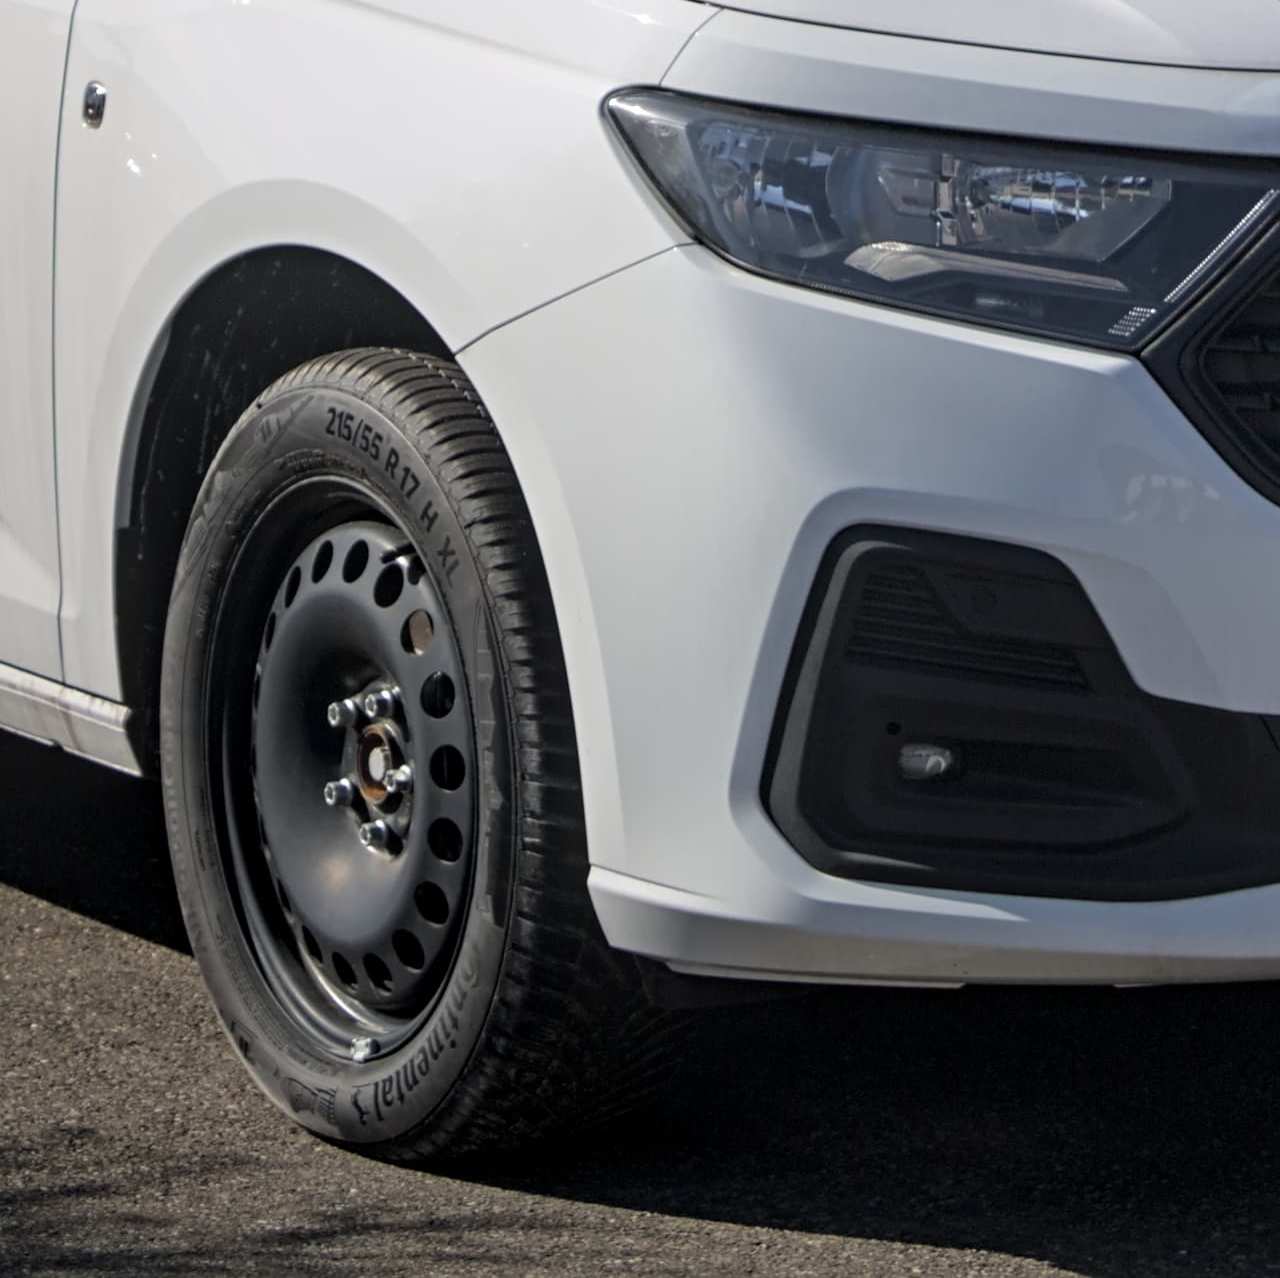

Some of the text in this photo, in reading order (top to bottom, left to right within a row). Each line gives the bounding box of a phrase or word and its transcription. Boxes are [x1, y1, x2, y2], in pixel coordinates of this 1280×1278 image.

[325, 407, 460, 588] 215/55 R 17 H XL
[372, 938, 482, 1122] Continental
